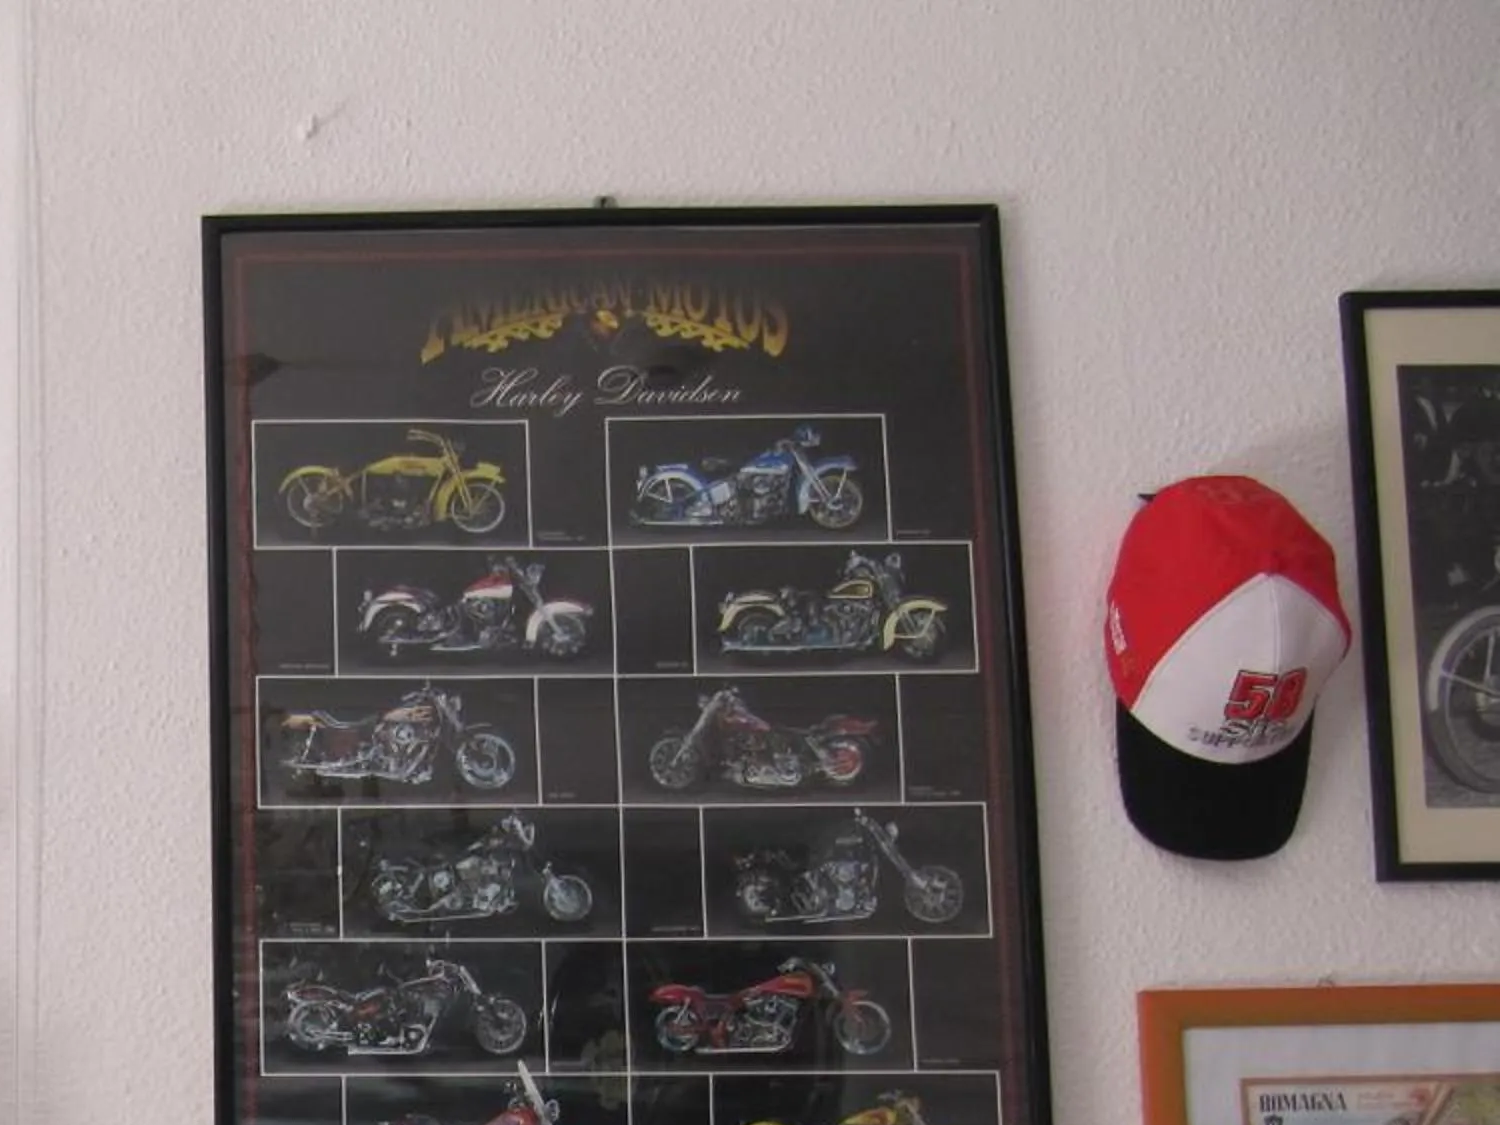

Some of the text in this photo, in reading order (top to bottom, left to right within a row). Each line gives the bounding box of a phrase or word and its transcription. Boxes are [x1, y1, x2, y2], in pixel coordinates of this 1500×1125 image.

[469, 364, 744, 417] Harley Davidson
[1223, 667, 1308, 720] 58
[1258, 1092, 1347, 1113] ROMAGNA
